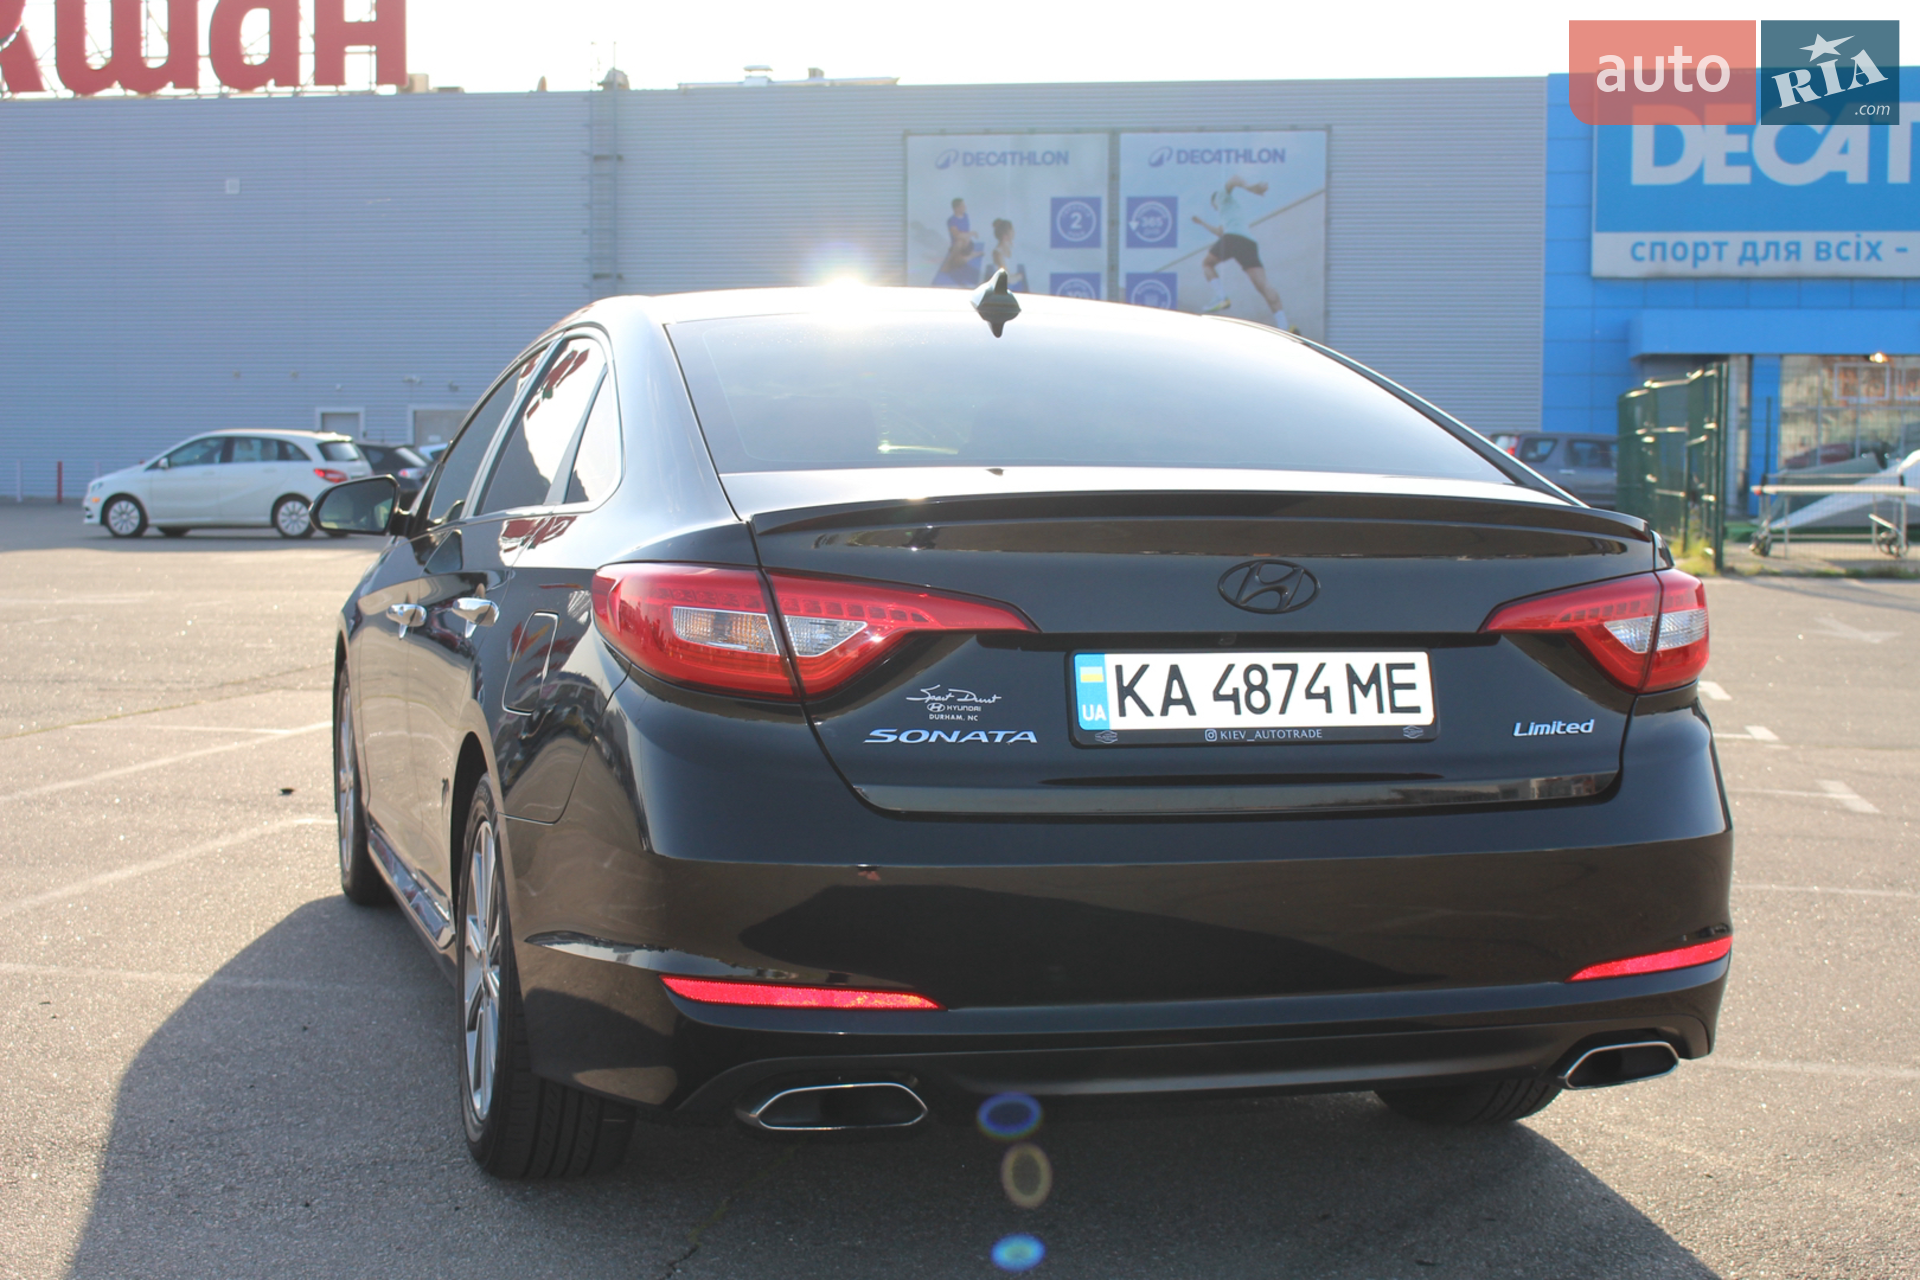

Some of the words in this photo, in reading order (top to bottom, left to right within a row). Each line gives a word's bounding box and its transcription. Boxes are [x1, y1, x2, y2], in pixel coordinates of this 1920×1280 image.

[962, 150, 1069, 167] DECATHLON
[1176, 148, 1286, 165] DECATHLON
[1070, 211, 1083, 230] 2
[1630, 240, 1729, 268] спорт
[1738, 240, 1802, 266] для
[1814, 234, 1884, 262] всіх
[1115, 663, 1198, 718] KA
[1212, 662, 1333, 716] 4874
[1345, 662, 1422, 715] ME
[946, 704, 982, 712] HYUNDAI
[1082, 704, 1108, 721] UA
[863, 728, 1038, 744] SONATA
[1220, 728, 1323, 742] KIEV_AUTOTRADE
[1513, 719, 1596, 737] Limited
